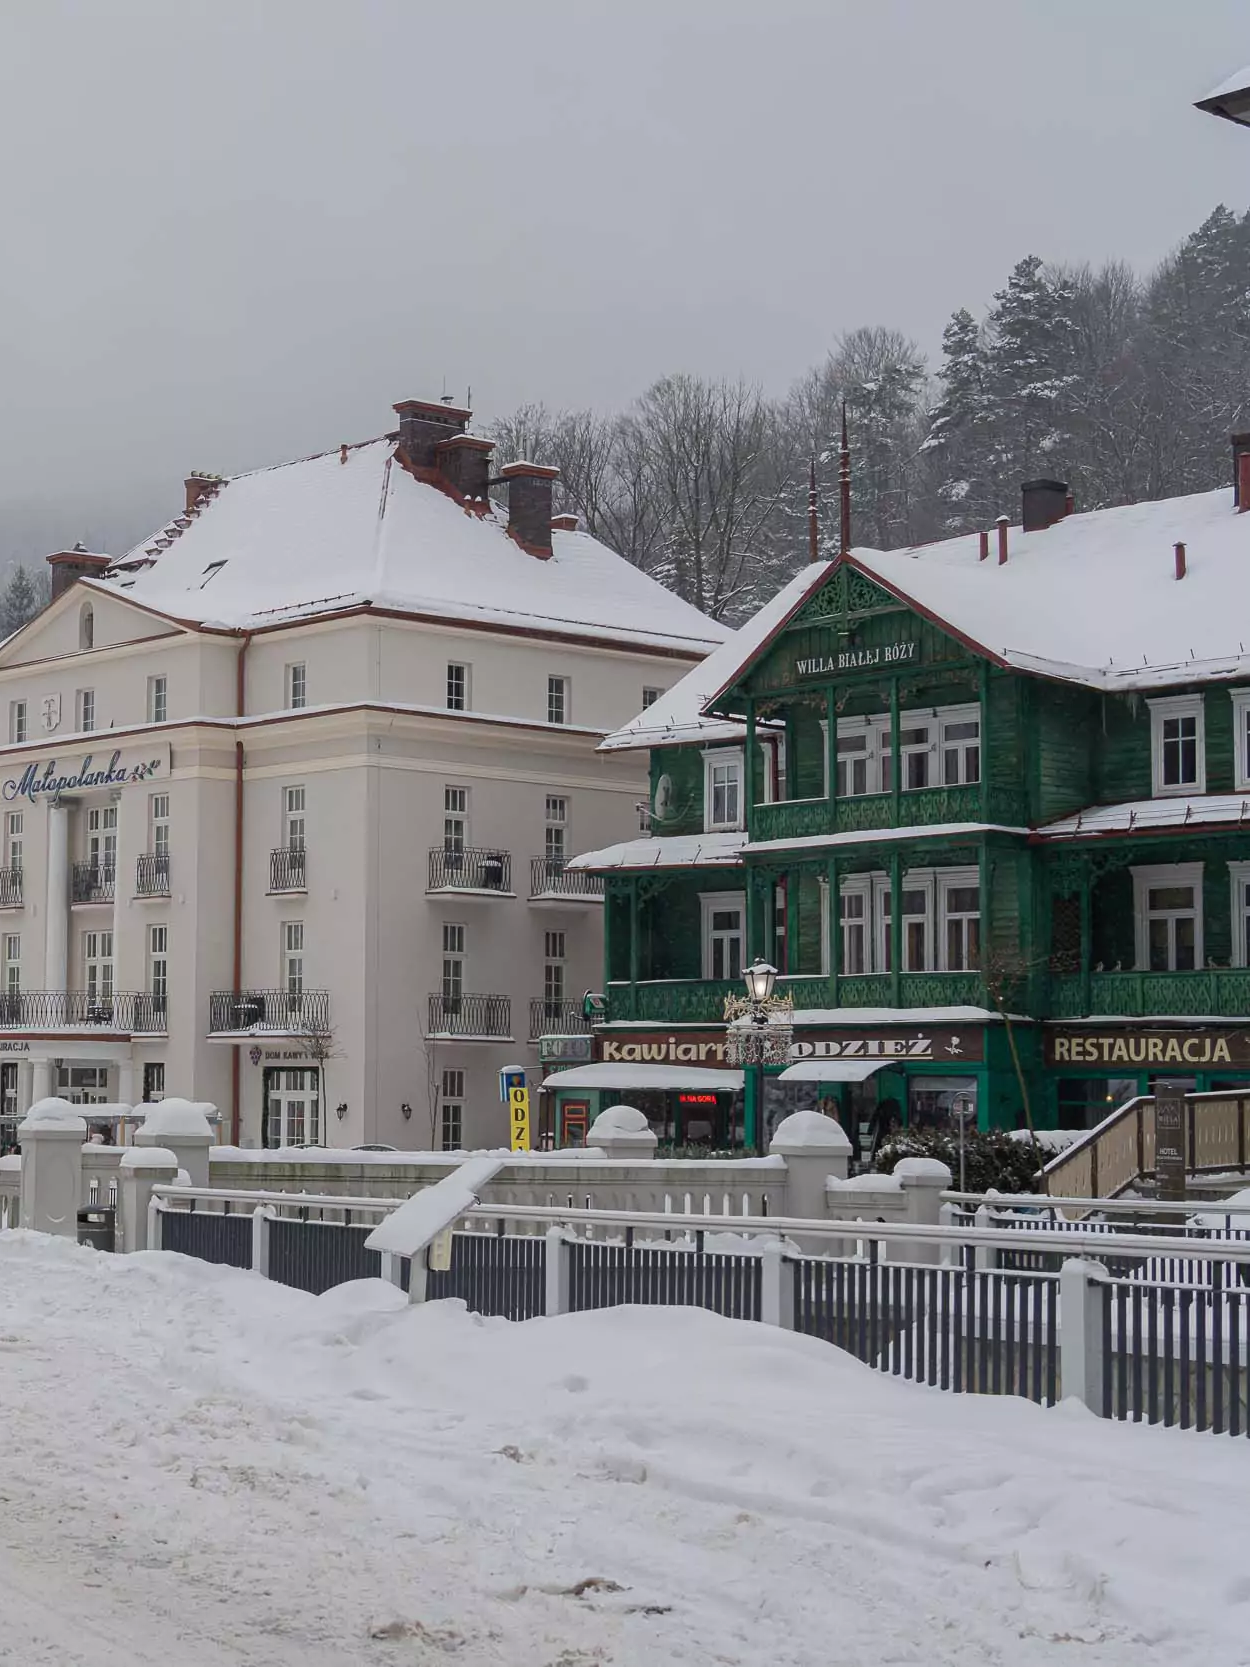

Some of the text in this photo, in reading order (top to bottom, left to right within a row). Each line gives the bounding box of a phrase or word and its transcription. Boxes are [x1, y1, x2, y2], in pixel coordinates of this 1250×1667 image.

[796, 641, 915, 675] WILLA BIAŁEJ RÓŻY
[1, 750, 130, 804] Małopolanka
[265, 1051, 281, 1059] DOM
[788, 1032, 932, 1058] ODZIEŻ
[1054, 1037, 1232, 1062] RESTAURACJA
[1159, 1147, 1178, 1156] HOTEL
